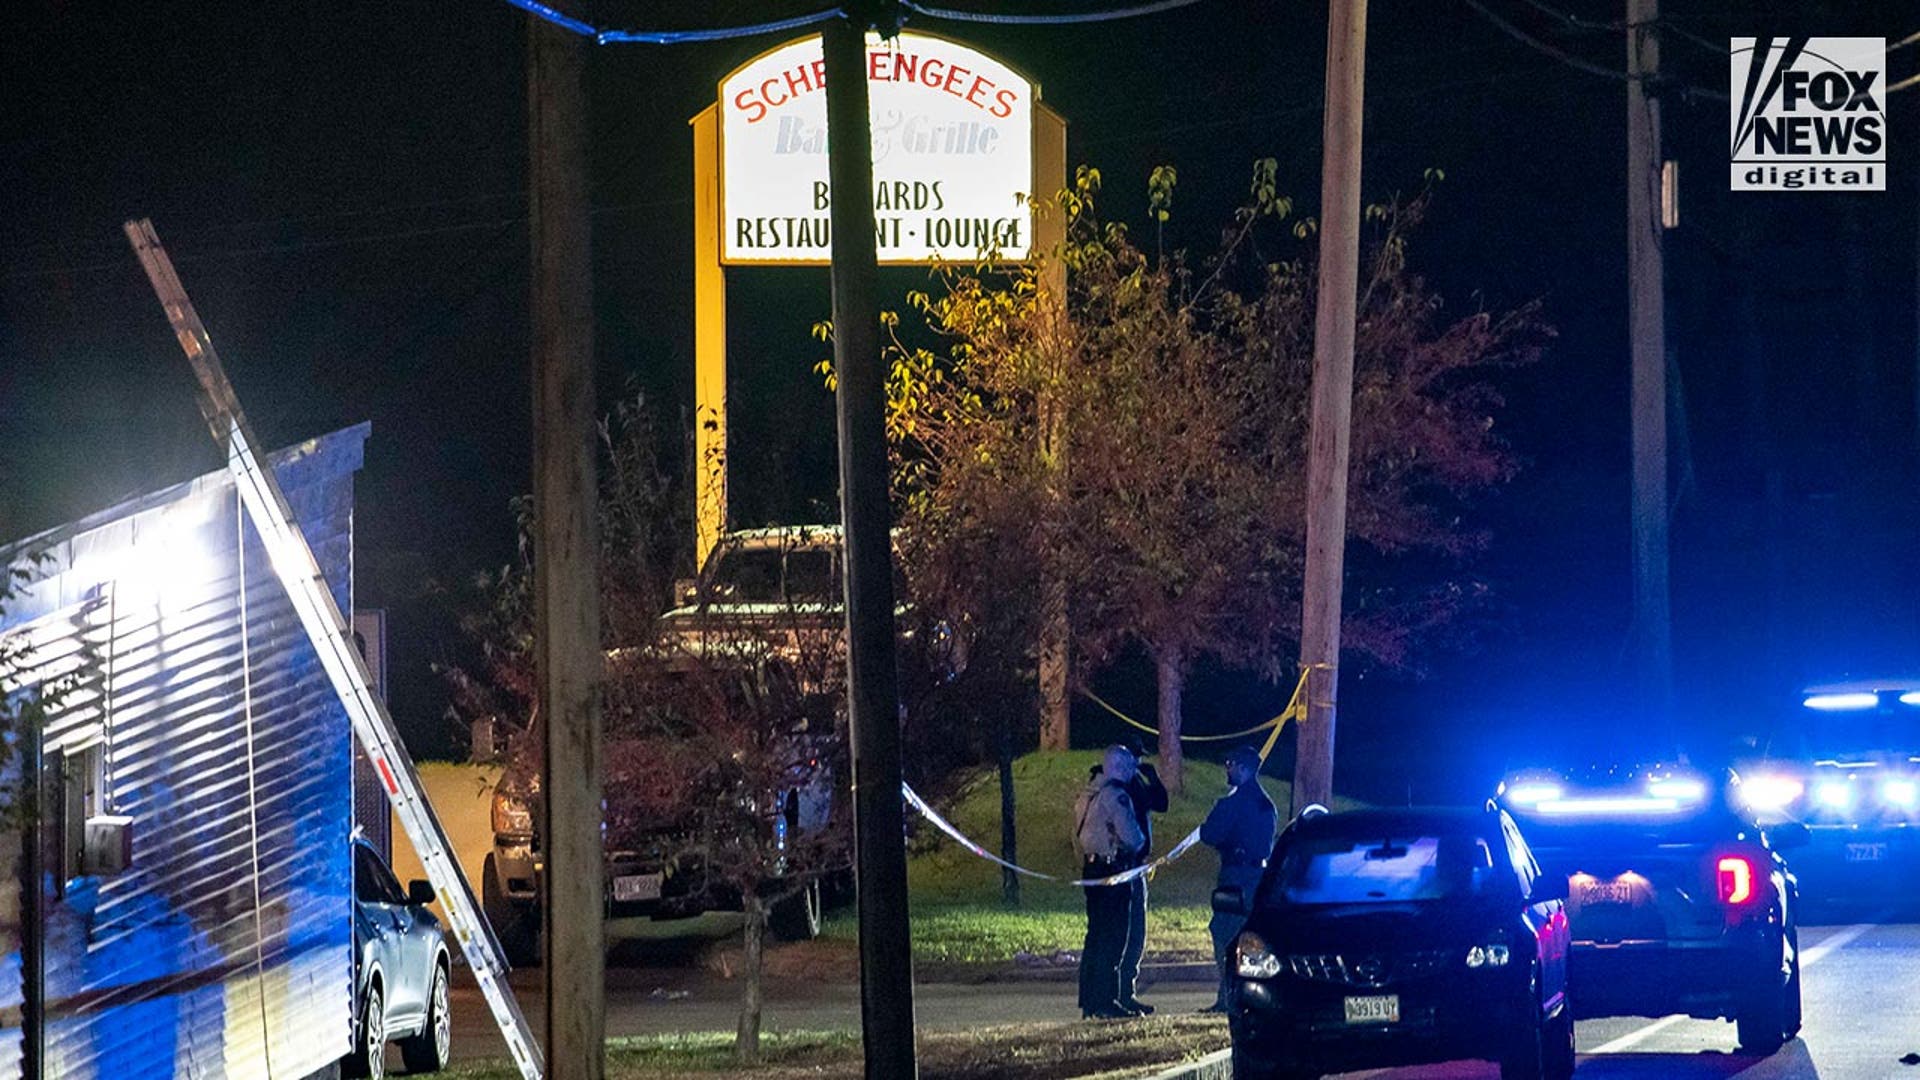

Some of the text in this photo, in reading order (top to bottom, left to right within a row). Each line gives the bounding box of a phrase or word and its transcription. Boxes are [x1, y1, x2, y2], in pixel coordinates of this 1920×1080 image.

[735, 52, 1018, 123] SCHEENGEES
[901, 114, 1000, 154] Grille
[813, 181, 945, 210] BARDS
[736, 217, 1022, 249] RESTAUNT LOUNGE
